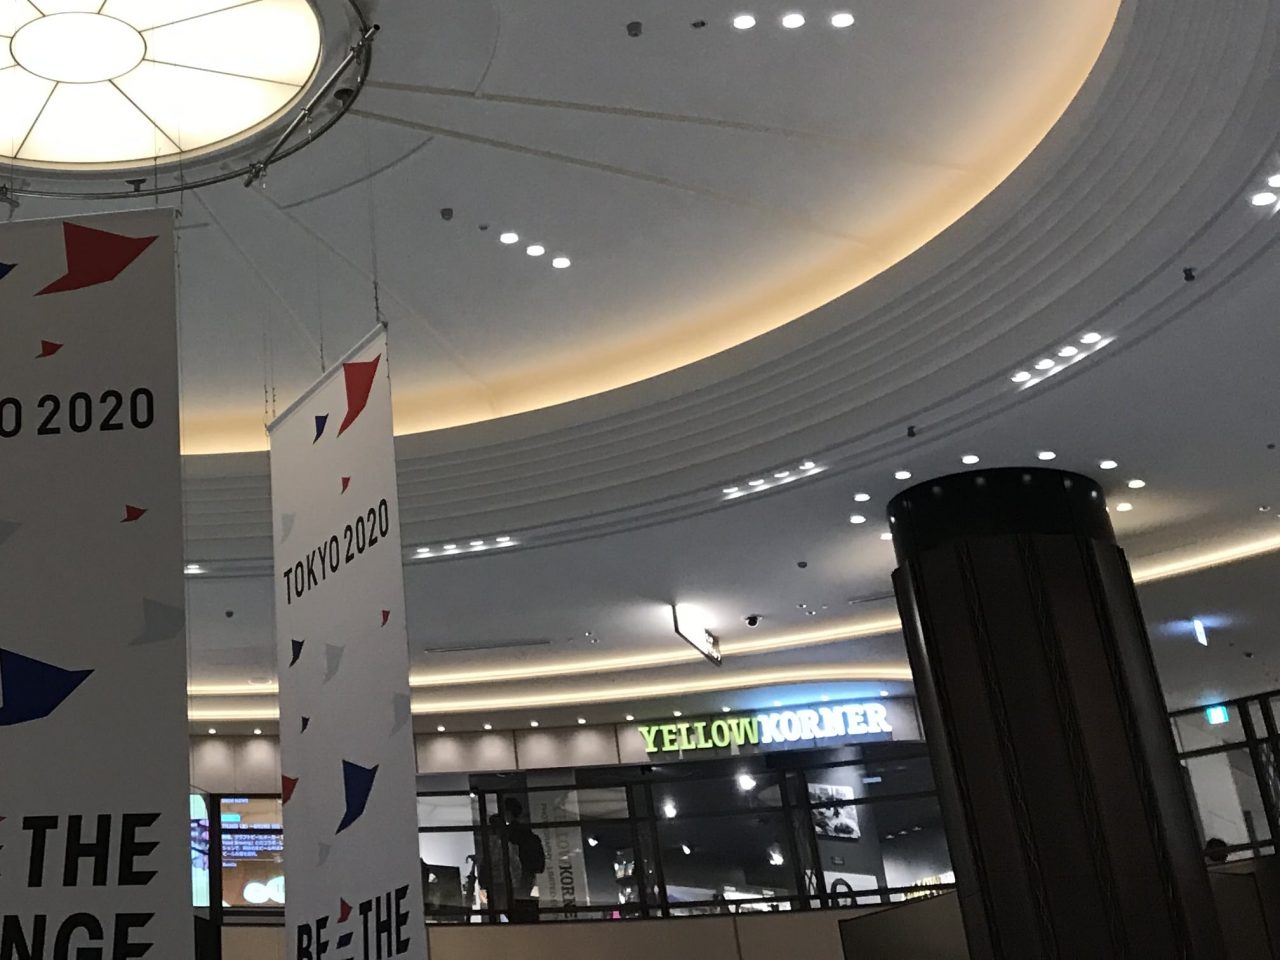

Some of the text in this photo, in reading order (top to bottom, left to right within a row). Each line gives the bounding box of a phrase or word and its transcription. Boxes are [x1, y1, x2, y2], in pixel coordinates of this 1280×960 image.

[36, 387, 154, 435] 2020
[283, 498, 389, 605] TOKYO 2020
[22, 812, 162, 888] THE
[297, 884, 411, 960] BE THE
